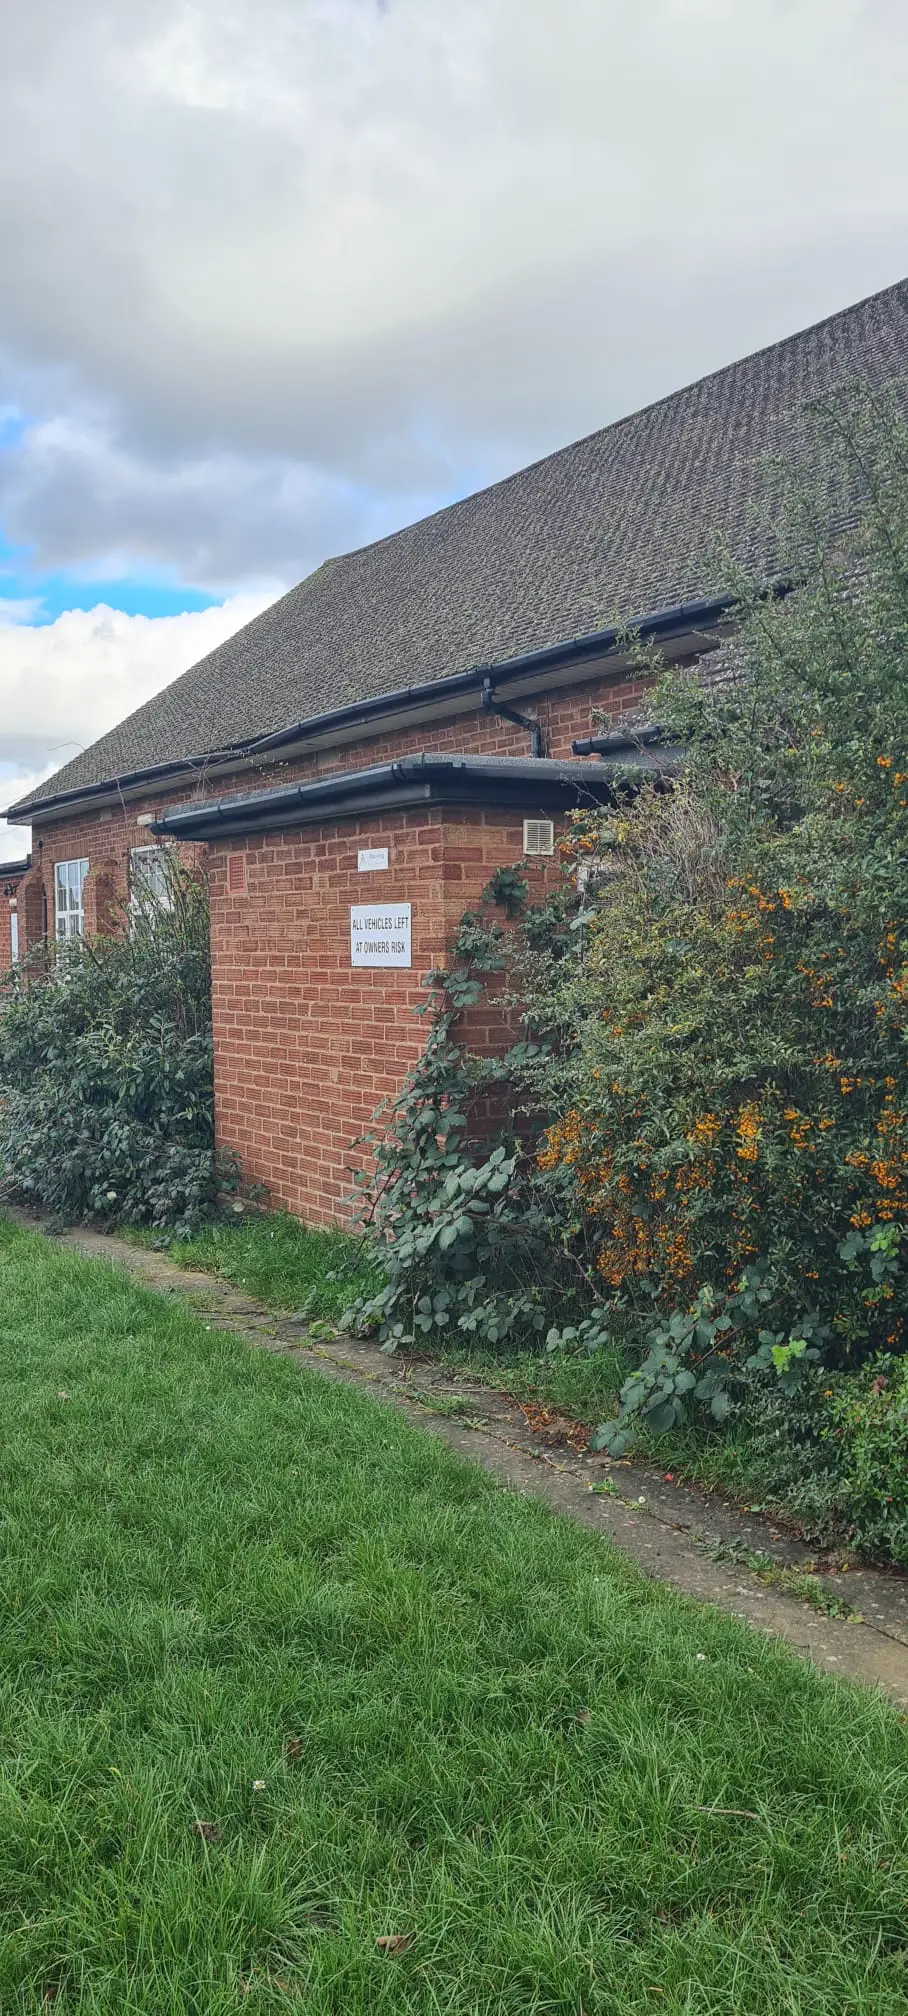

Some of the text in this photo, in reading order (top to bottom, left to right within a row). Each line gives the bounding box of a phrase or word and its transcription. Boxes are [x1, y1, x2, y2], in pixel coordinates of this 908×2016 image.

[352, 917, 408, 930] ALL VEHICLES LEFT
[356, 941, 405, 954] AT OWNERS RISK
